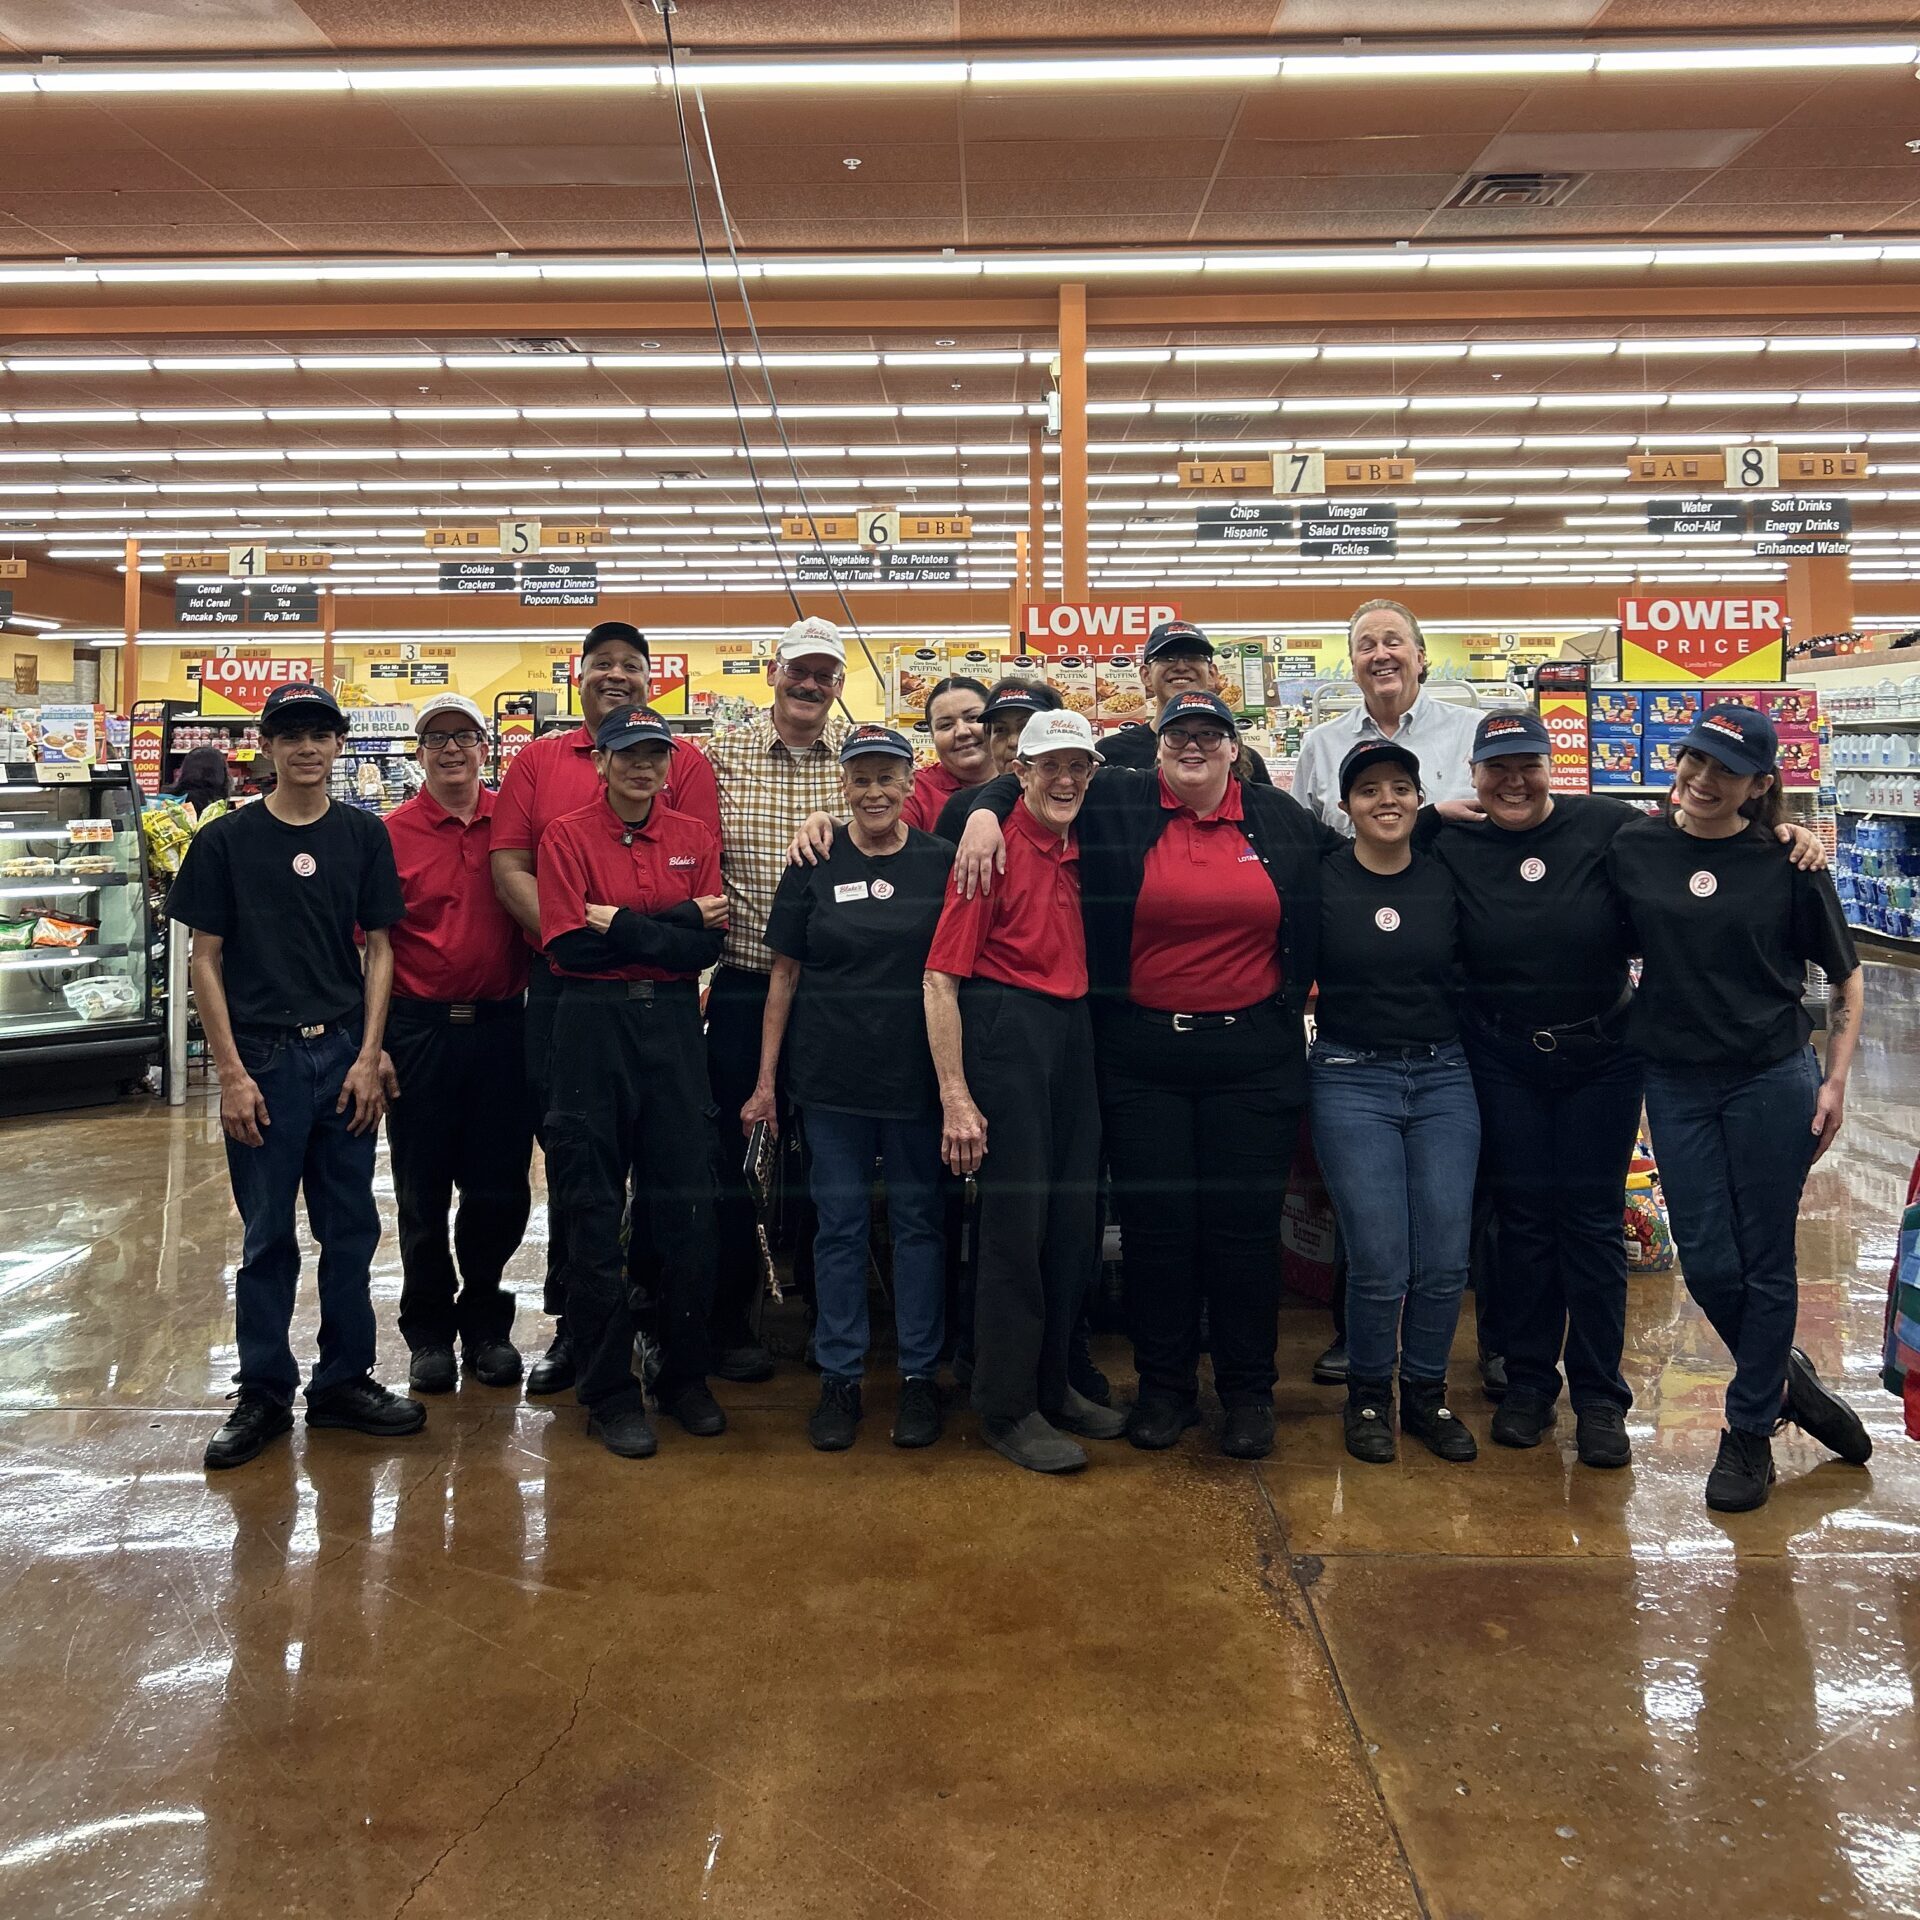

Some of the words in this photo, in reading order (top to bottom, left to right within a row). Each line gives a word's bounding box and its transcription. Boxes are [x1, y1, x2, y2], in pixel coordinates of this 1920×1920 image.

[1212, 468, 1225, 483] A
[1290, 455, 1309, 492] 7
[1369, 465, 1381, 481] B
[1662, 461, 1677, 477] A
[1742, 448, 1764, 487] 8
[1822, 459, 1834, 475] B
[1681, 501, 1713, 513] Water
[1771, 500, 1796, 512] Soft
[1798, 500, 1832, 511] Drinks
[1230, 507, 1260, 520] Chips
[1328, 506, 1369, 519] Vinegar
[868, 513, 888, 544] 6
[936, 522, 945, 535] B
[1308, 525, 1339, 537] Salad
[1342, 525, 1389, 538] Dressing
[1673, 520, 1721, 532] Kool-Aid
[1765, 519, 1802, 533] Energy
[1806, 519, 1840, 531] Drinks
[450, 534, 461, 545] A
[511, 523, 528, 554] 5
[576, 532, 585, 544] B
[1223, 526, 1268, 540] Hispanic
[1331, 543, 1370, 555] Pickles
[1756, 541, 1814, 555] Enhanced
[1817, 541, 1850, 554] Water
[186, 555, 196, 567] A
[239, 547, 254, 575] 4
[299, 555, 307, 566] B
[829, 555, 870, 566] Vegetables
[891, 554, 908, 564] Box
[910, 554, 949, 564] Potatoes
[460, 564, 495, 574] Cookies
[547, 564, 570, 575] Soup
[799, 570, 828, 580] Canned
[829, 570, 849, 580] eat
[854, 571, 873, 580] Tuna
[889, 570, 915, 580] Pasta
[921, 570, 950, 580] Sauce
[197, 585, 223, 594] Cereal
[270, 584, 297, 594] Coffee
[457, 578, 496, 590] Crackers
[523, 579, 561, 590] Prepared
[563, 579, 595, 589] Dinners
[189, 598, 204, 608] Hot
[206, 598, 231, 608] Cereal
[277, 598, 290, 607] Tea
[524, 594, 594, 607] Popcorn/Snacks
[181, 612, 213, 621] Pancake
[215, 612, 238, 623] Syrup
[263, 612, 279, 622] Pop
[282, 612, 300, 621] Tarts
[1028, 605, 1176, 636] LOWER
[1626, 600, 1781, 631] LOWER
[757, 640, 766, 656] 5
[1272, 637, 1282, 652] 8
[1505, 634, 1515, 651] 9
[1657, 639, 1750, 654] PRICE
[406, 644, 415, 660] 3
[205, 660, 308, 681] LOWER
[528, 670, 547, 679] Fish,
[224, 686, 272, 696] PRIC
[368, 710, 397, 722] BAKED
[372, 722, 410, 732] BREAD
[1051, 720, 1080, 730] Blake's
[1543, 718, 1585, 730] LOOK
[502, 734, 532, 743] LOOK
[1046, 729, 1086, 738] LOTABURGER
[133, 739, 160, 747] LOOK
[133, 750, 160, 760] FOR
[502, 745, 525, 757] FO
[668, 855, 696, 866] Blake's
[1383, 912, 1393, 924] B
